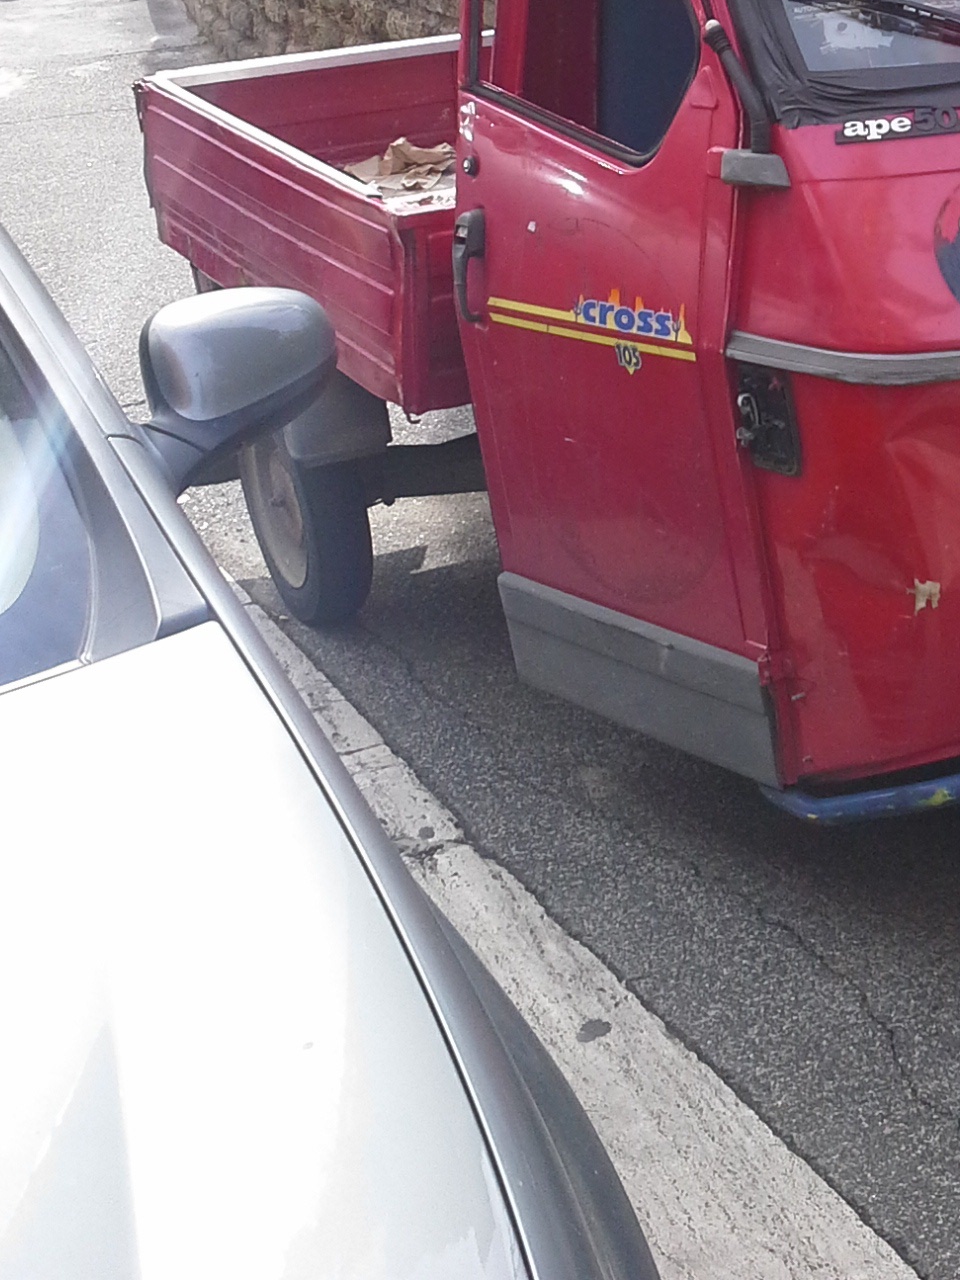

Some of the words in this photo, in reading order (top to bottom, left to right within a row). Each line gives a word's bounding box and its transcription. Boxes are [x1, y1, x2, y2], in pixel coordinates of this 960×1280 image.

[843, 116, 912, 141] ape
[913, 106, 958, 132] 50
[582, 300, 672, 337] cross
